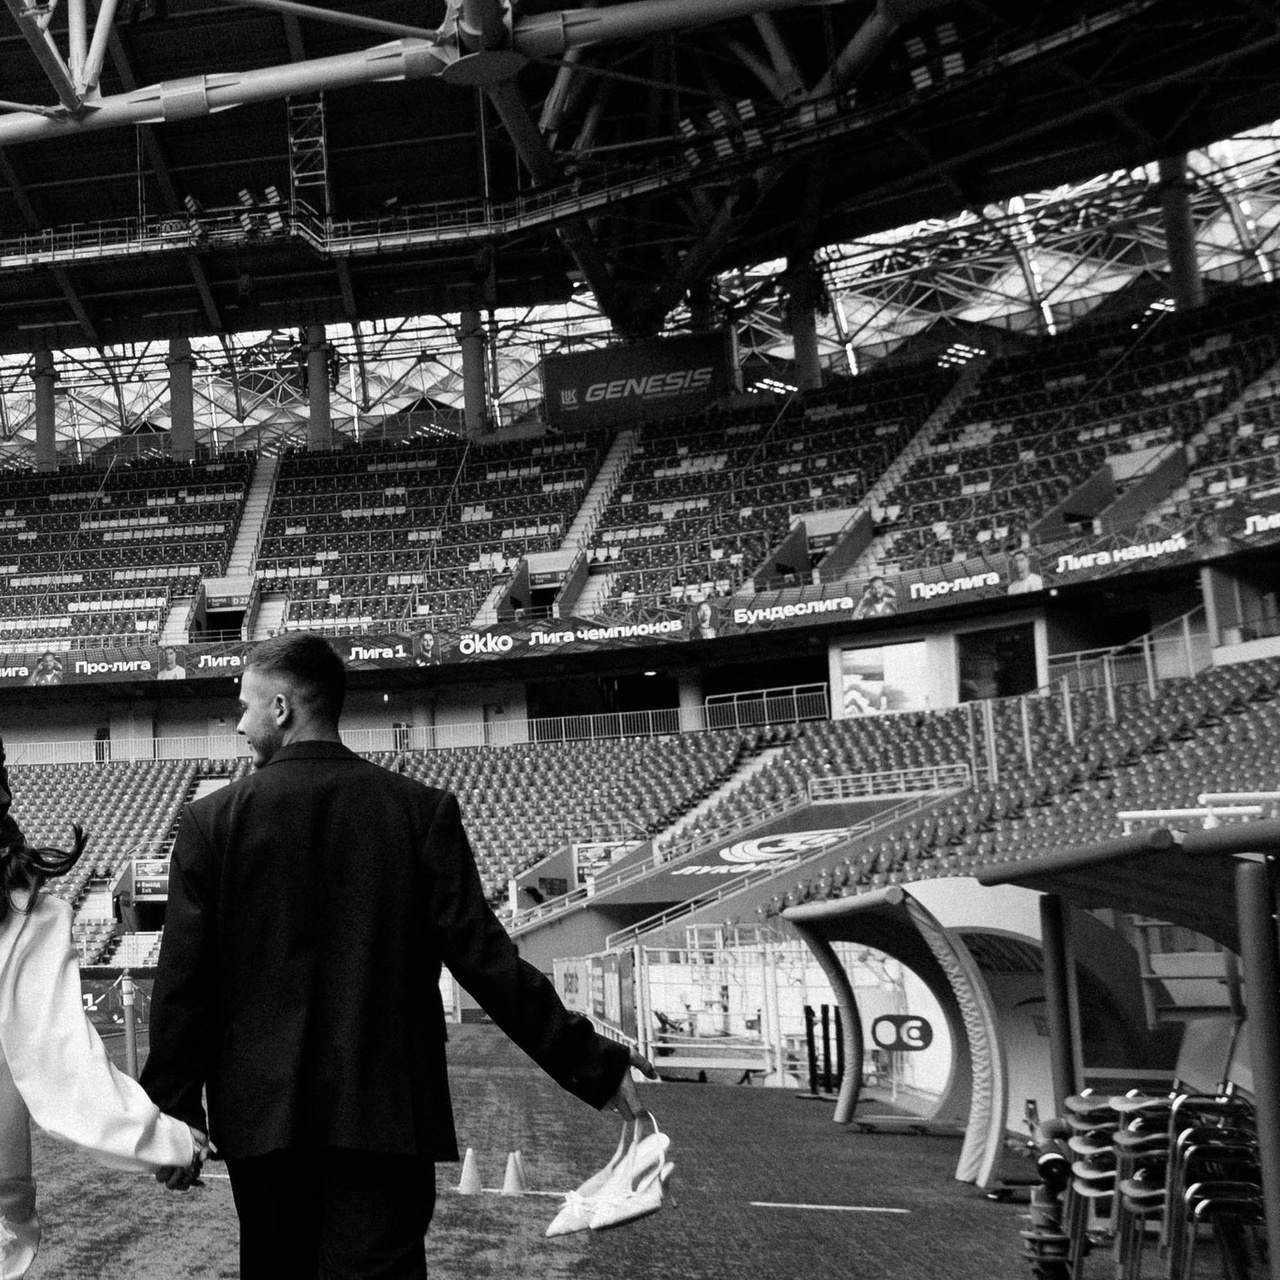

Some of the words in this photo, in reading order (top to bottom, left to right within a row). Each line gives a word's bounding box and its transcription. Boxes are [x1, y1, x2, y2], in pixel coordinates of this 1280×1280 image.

[584, 367, 714, 402] GENESIS
[1055, 550, 1111, 574] Лига
[1112, 531, 1188, 563] наций
[733, 595, 854, 625] Бундеслига
[528, 629, 574, 647] Лига
[575, 619, 683, 642] чемпионов
[198, 655, 241, 668] Лига
[348, 646, 394, 662] Лига
[394, 644, 407, 660] 1
